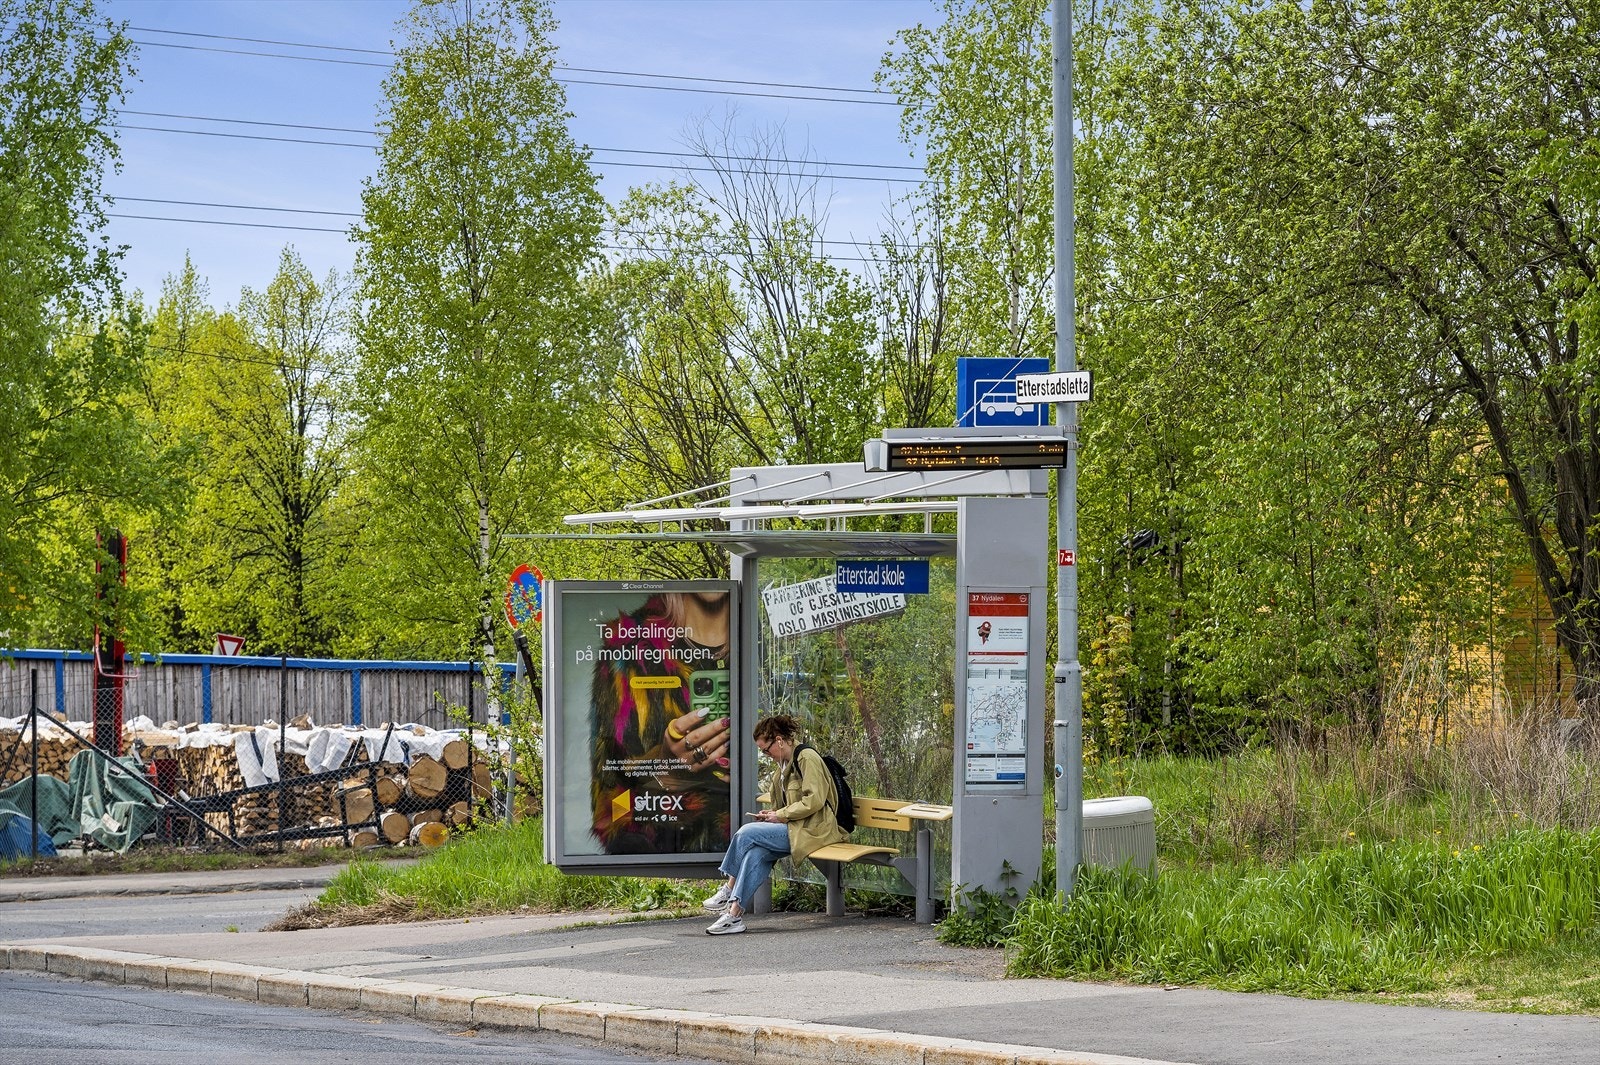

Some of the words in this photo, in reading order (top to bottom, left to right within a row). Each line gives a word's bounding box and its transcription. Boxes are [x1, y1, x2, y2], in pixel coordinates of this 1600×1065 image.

[1017, 377, 1088, 397] Etterstadsletta
[837, 564, 880, 586] Etterstad
[881, 564, 905, 586] skole
[790, 600, 804, 616] OG
[971, 594, 980, 602] 37
[981, 594, 1004, 603] Nydalen
[778, 617, 807, 635] OSLO
[811, 594, 902, 628] MASKINISTSKOLE
[595, 624, 613, 639] Ta
[618, 623, 693, 642] betalingen
[575, 645, 593, 664] på
[598, 645, 714, 663] mobilregningen.
[634, 790, 684, 811] strex
[668, 814, 678, 822] ice
